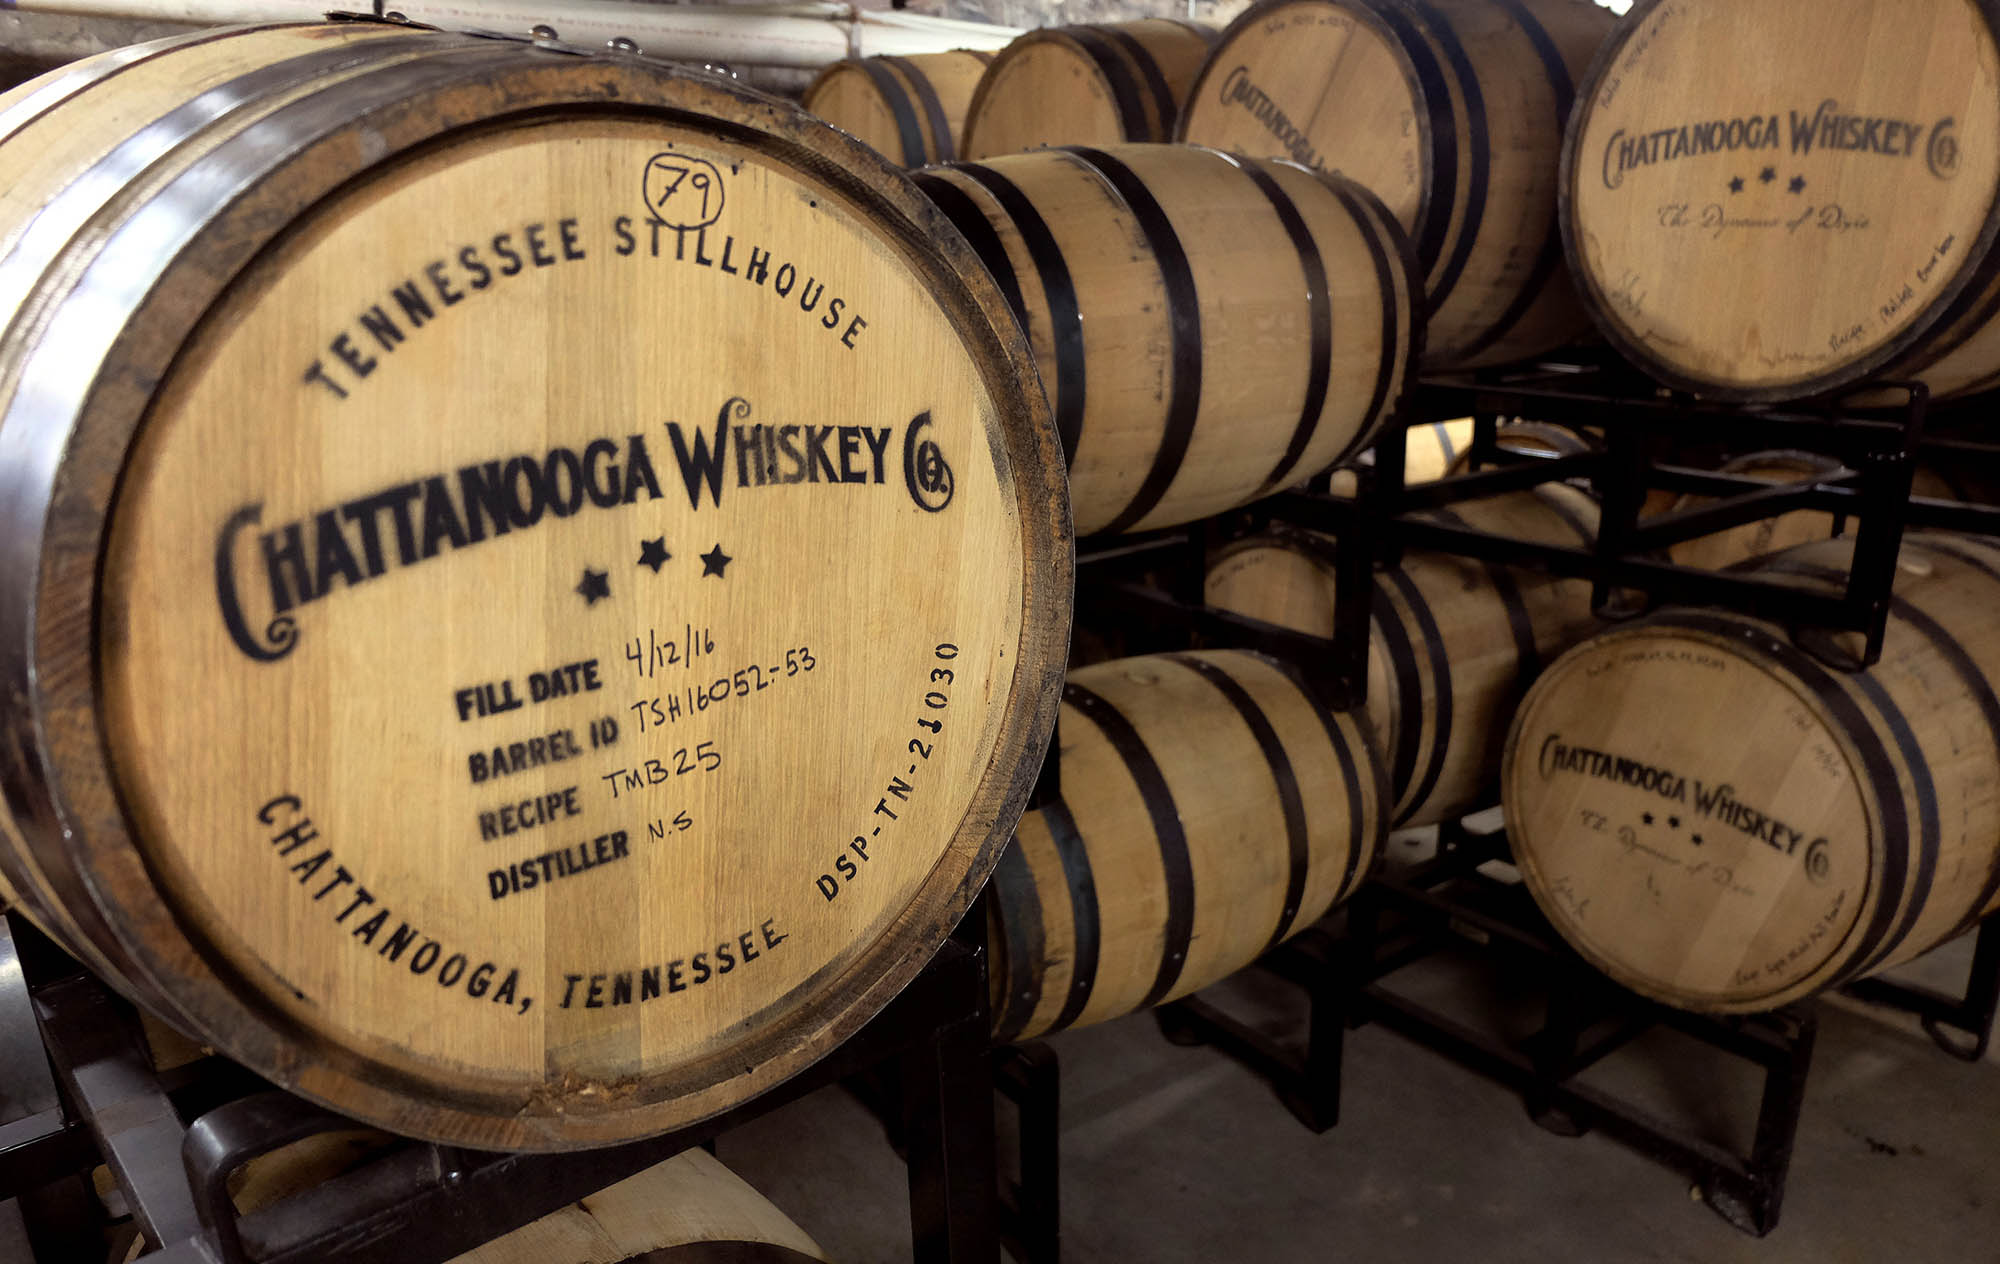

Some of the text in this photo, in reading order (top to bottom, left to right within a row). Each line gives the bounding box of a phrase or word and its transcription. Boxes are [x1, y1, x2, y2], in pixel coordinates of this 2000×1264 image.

[1603, 115, 1780, 190] CHATTANOOGA
[1790, 99, 1922, 157] WHISKEY
[653, 165, 712, 219] 79
[303, 216, 868, 400] TENNESSEE STILLHOUSE
[215, 434, 664, 662] CHATTANOOGA
[665, 397, 892, 511] WHISKEY
[455, 658, 603, 722] FILL DATE
[625, 624, 715, 678] 4/12/16
[468, 715, 620, 785] BARREL ID
[815, 643, 959, 901] DSP-TN-21030
[478, 786, 582, 842] RECIPE
[1539, 734, 1687, 803] CHATTANOOGA
[1694, 780, 1803, 857] WHISKEY
[256, 794, 790, 1017] CHATTANOOGA, TENNESSEE
[487, 829, 631, 901] DISTILLER
